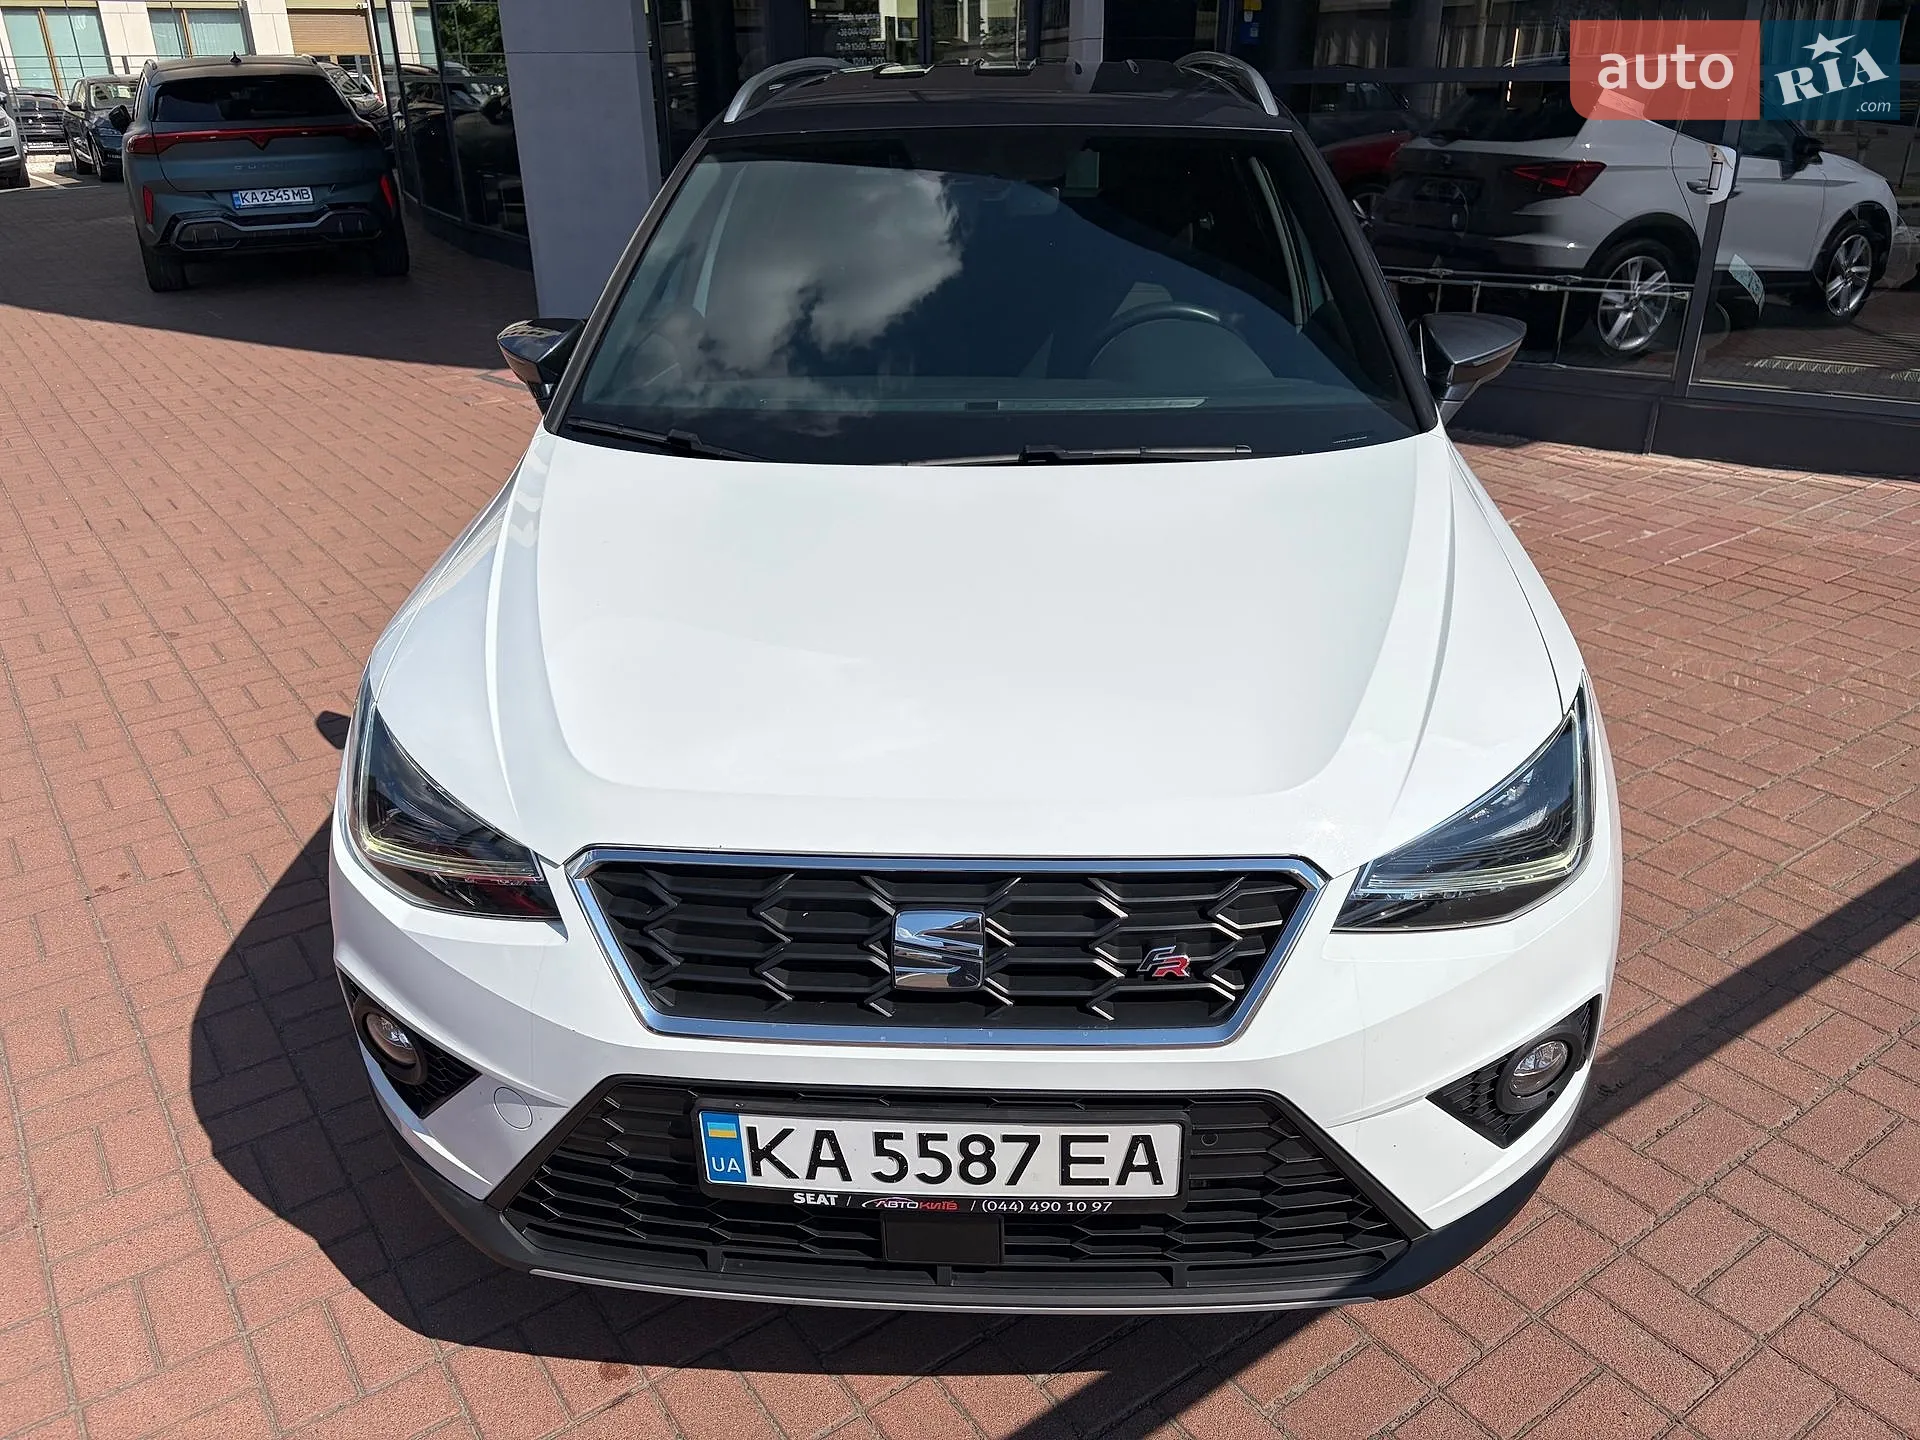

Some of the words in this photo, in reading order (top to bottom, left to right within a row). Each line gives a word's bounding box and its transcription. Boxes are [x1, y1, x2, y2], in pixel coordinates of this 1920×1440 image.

[260, 189, 290, 202] 2545
[291, 188, 311, 201] MB
[1136, 945, 1191, 978] FR
[712, 1157, 742, 1174] UA
[747, 1126, 853, 1182] KA
[871, 1131, 1042, 1186] 5587
[1060, 1133, 1164, 1186] EA
[793, 1192, 838, 1206] SEAT
[982, 1200, 1024, 1213] (044)
[1029, 1201, 1061, 1212] 490
[1067, 1201, 1086, 1212] 10
[1091, 1201, 1113, 1212] 97
